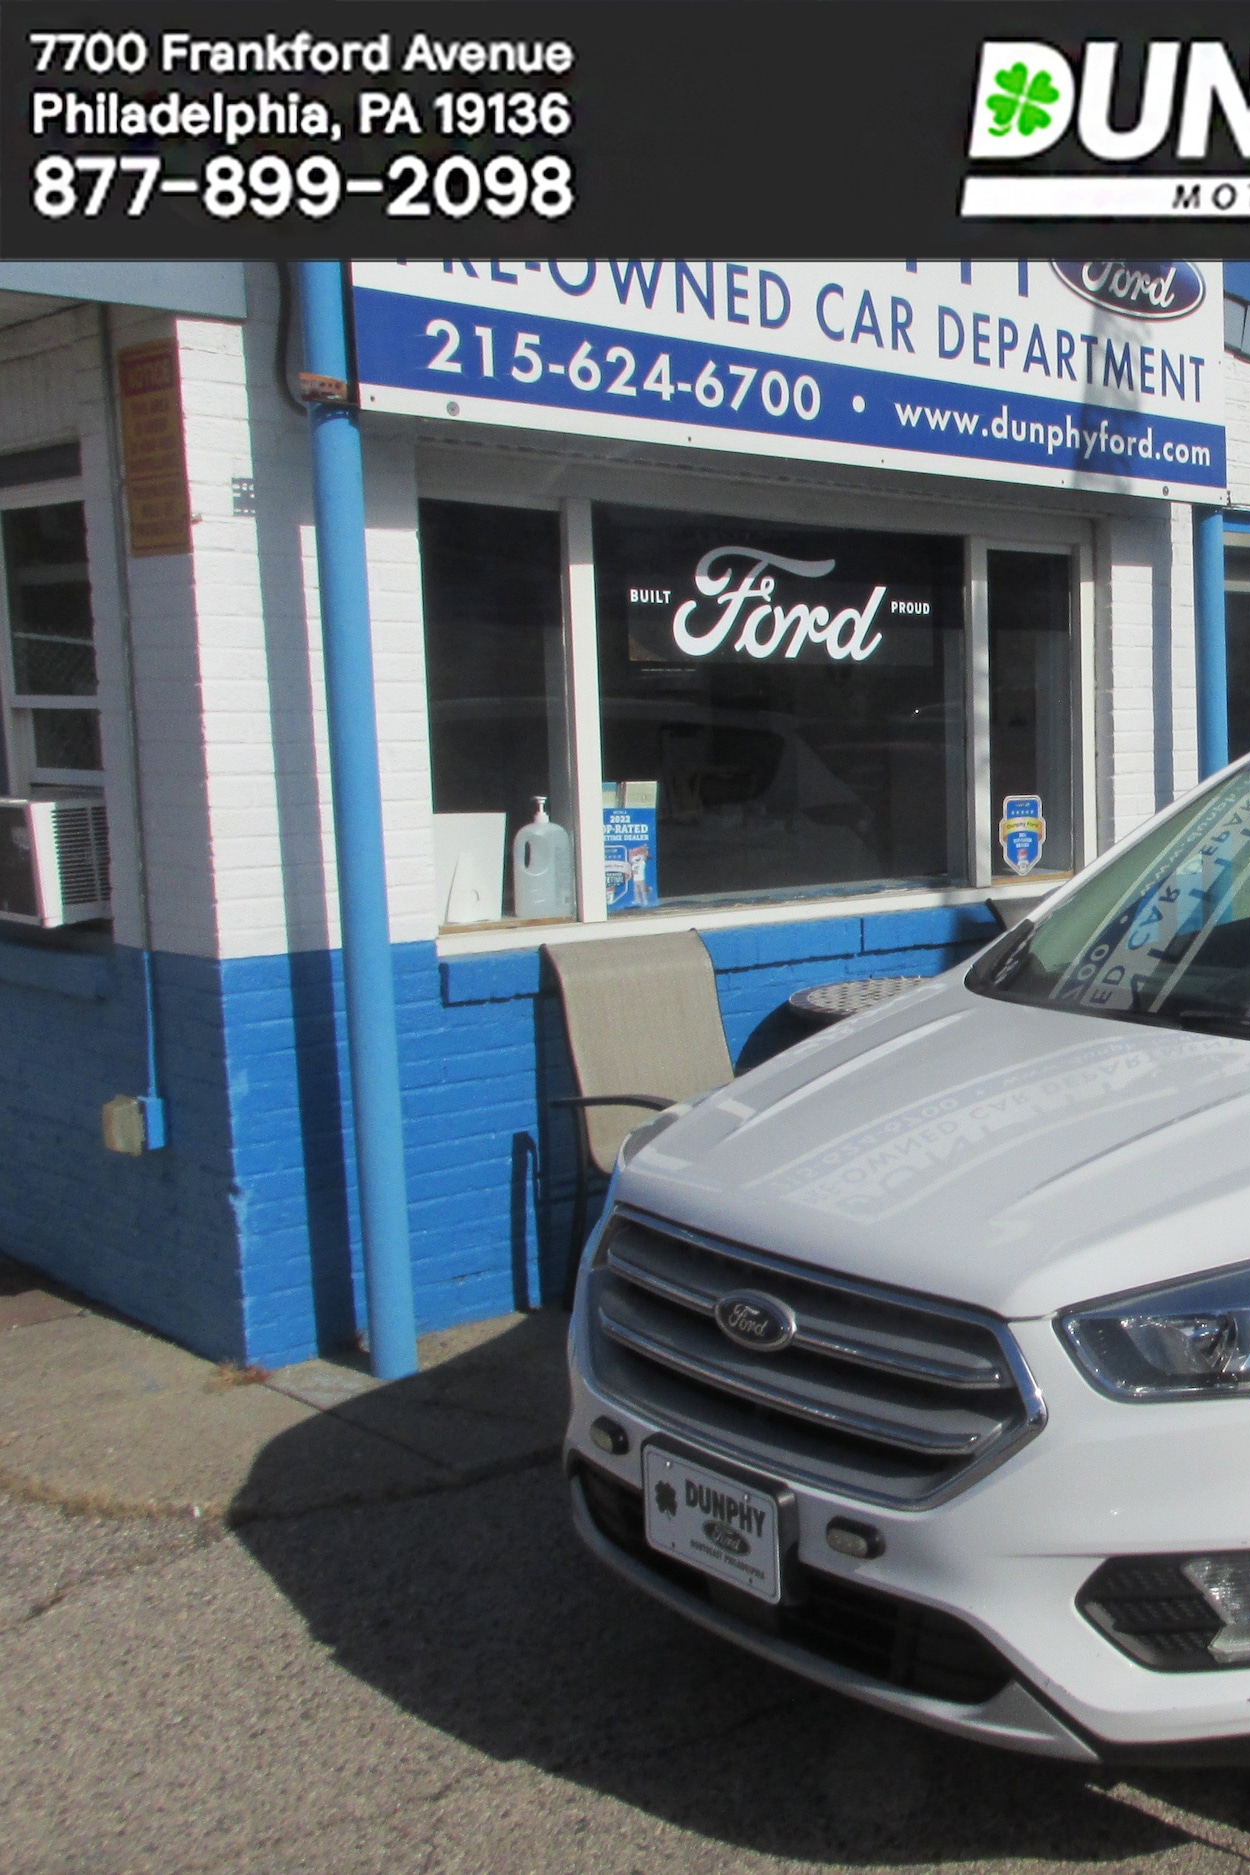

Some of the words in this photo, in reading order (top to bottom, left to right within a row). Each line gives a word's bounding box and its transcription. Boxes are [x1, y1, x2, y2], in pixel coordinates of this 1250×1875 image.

[425, 318, 821, 421] 215-624-6700
[894, 401, 1211, 467] www.dunphyford.com
[815, 282, 916, 355] CAR
[937, 305, 1206, 403] DEPARTMENT
[629, 588, 671, 604] BUILT
[673, 545, 887, 661] Ford
[891, 600, 930, 615] PROUD
[728, 1303, 769, 1337] Ford
[684, 1478, 766, 1538] DUNPHY
